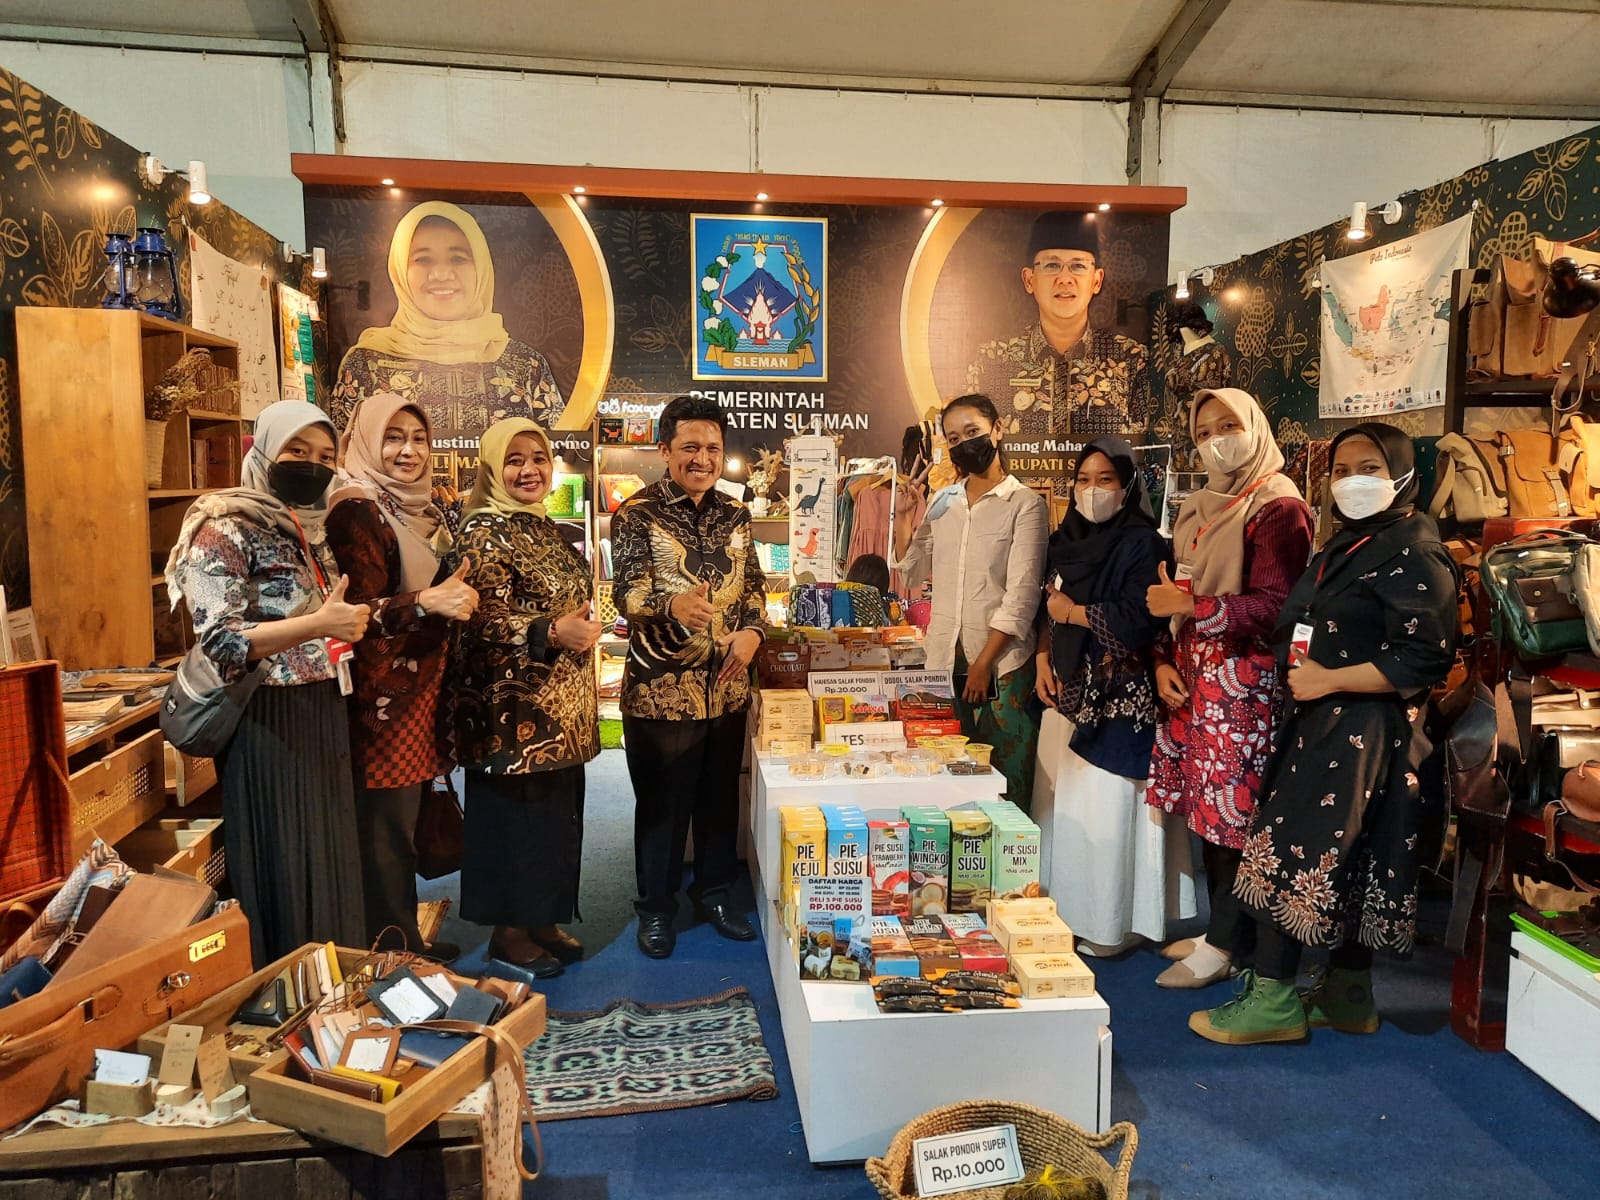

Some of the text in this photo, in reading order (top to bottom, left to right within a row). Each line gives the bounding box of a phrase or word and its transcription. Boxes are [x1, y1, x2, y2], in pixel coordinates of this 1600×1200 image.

[733, 356, 788, 368] SLEMAN
[727, 412, 869, 430] ATEN SLEMAN
[431, 436, 479, 448] ustini
[1004, 439, 1086, 453] nang Maha
[1009, 458, 1064, 470] BUPATI
[838, 677, 854, 685] SALAK
[855, 676, 876, 684] PONDOH
[924, 675, 948, 683] PONDOH
[825, 686, 867, 694] Rp.20.000
[841, 734, 864, 745] TES
[840, 844, 858, 858] PIE
[874, 843, 904, 852] PIE SUSU
[922, 840, 935, 851] PIE
[963, 839, 981, 854] PIE
[1003, 845, 1037, 855] PIE SUSU
[797, 845, 815, 859] PIE
[911, 852, 946, 864] WINGKO
[958, 857, 986, 870] SUSU
[1012, 857, 1027, 865] MIX
[792, 862, 819, 876] KEJU
[833, 861, 862, 875] SUSU
[809, 903, 862, 911] RP.100.000
[872, 920, 889, 928] PIE
[923, 1137, 1007, 1161] SALAK PONDOH SUPER
[932, 1157, 1005, 1183] Rp.10.000
